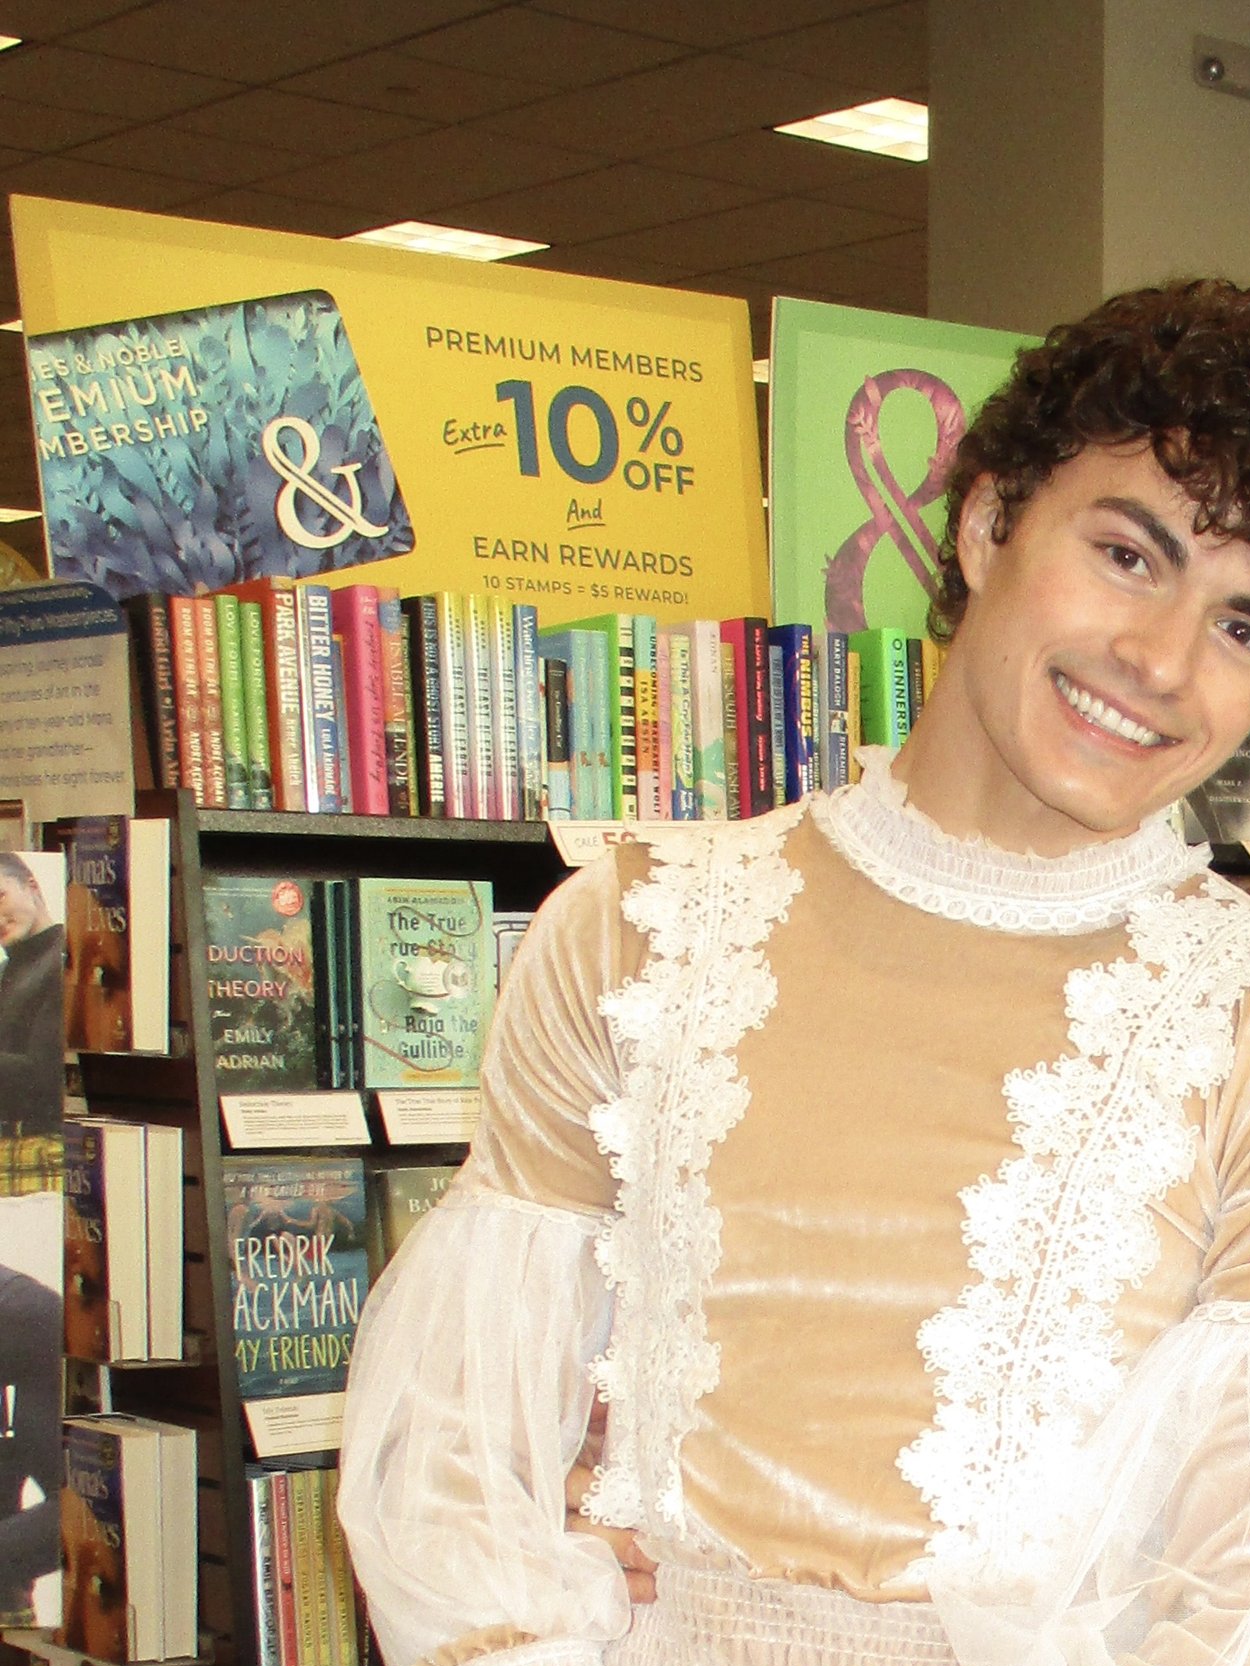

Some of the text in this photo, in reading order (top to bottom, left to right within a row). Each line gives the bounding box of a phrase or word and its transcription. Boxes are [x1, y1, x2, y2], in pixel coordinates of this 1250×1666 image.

[31, 339, 184, 381] ES & NOBLE
[426, 326, 703, 383] PREMIUM MEMBERS
[38, 366, 198, 423] EMIUM
[39, 409, 208, 460] MBERSHIP
[443, 418, 507, 447] Extra
[623, 460, 694, 495] OFF
[567, 499, 602, 523] And
[473, 536, 693, 577] EARN REWARDS
[483, 575, 688, 605] 10 STAMPS $5 REWARD!
[181, 608, 193, 636] ROOM
[202, 608, 214, 636] ROOM
[275, 593, 300, 714] PARK AVENUE
[308, 594, 335, 722] BITTER HONEY
[522, 615, 537, 677] Watching
[680, 648, 690, 659] Is
[834, 638, 842, 666] MARY
[389, 641, 405, 703] ISABEL
[649, 635, 659, 708] UNBECOMING
[680, 662, 690, 684] This
[799, 633, 814, 738] THE NIMBUS
[833, 667, 842, 707] BALOGH
[892, 637, 907, 736] O SINNERS!
[639, 680, 650, 703] ISA
[681, 698, 692, 721] Cry
[683, 723, 692, 742] For
[430, 753, 445, 802] AMERIE
[683, 742, 694, 779] Help?
[388, 911, 466, 931] The True
[208, 945, 304, 966] DUCTION
[224, 1027, 274, 1045] EMILY
[405, 1015, 444, 1037] Raja
[216, 1054, 285, 1070] ADRIAN
[400, 1040, 464, 1059] Gullible
[233, 1234, 336, 1281] FREDRIK
[233, 1278, 359, 1331] ACKMAN
[269, 1333, 351, 1373] FRIENDS
